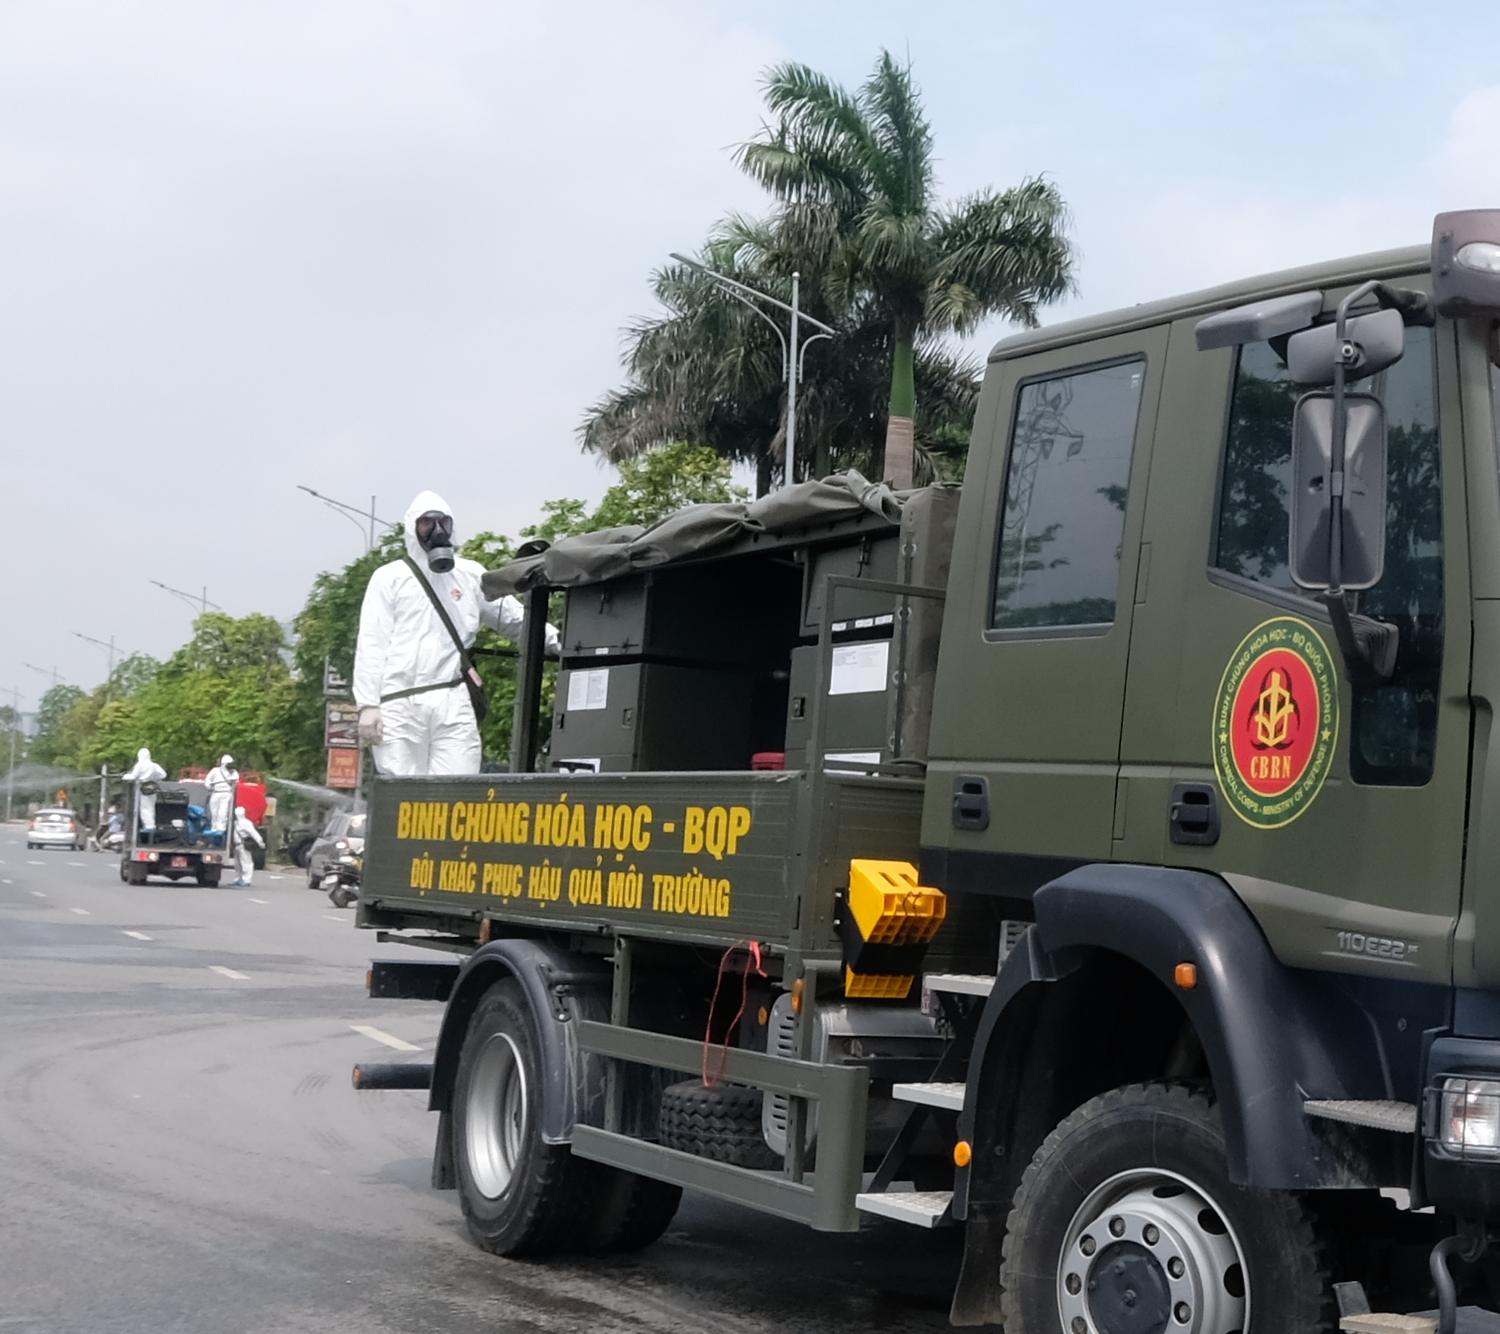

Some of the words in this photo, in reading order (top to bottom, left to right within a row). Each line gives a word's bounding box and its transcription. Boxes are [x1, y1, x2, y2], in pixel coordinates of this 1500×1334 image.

[1251, 756, 1291, 779] CBRN
[397, 802, 448, 840] BINH
[450, 788, 530, 844] CHỦNG
[533, 793, 586, 847] HÓA
[594, 804, 652, 862] HỌC
[662, 822, 675, 833] -
[683, 806, 751, 860] BQP
[410, 851, 434, 896] ĐỘI
[439, 845, 477, 893] KHẮC
[482, 863, 523, 904] PHỤC
[528, 858, 562, 908] HẬU
[568, 855, 602, 907] QUẢ
[607, 864, 644, 909] MÔI
[652, 867, 731, 917] TRƯỜNG
